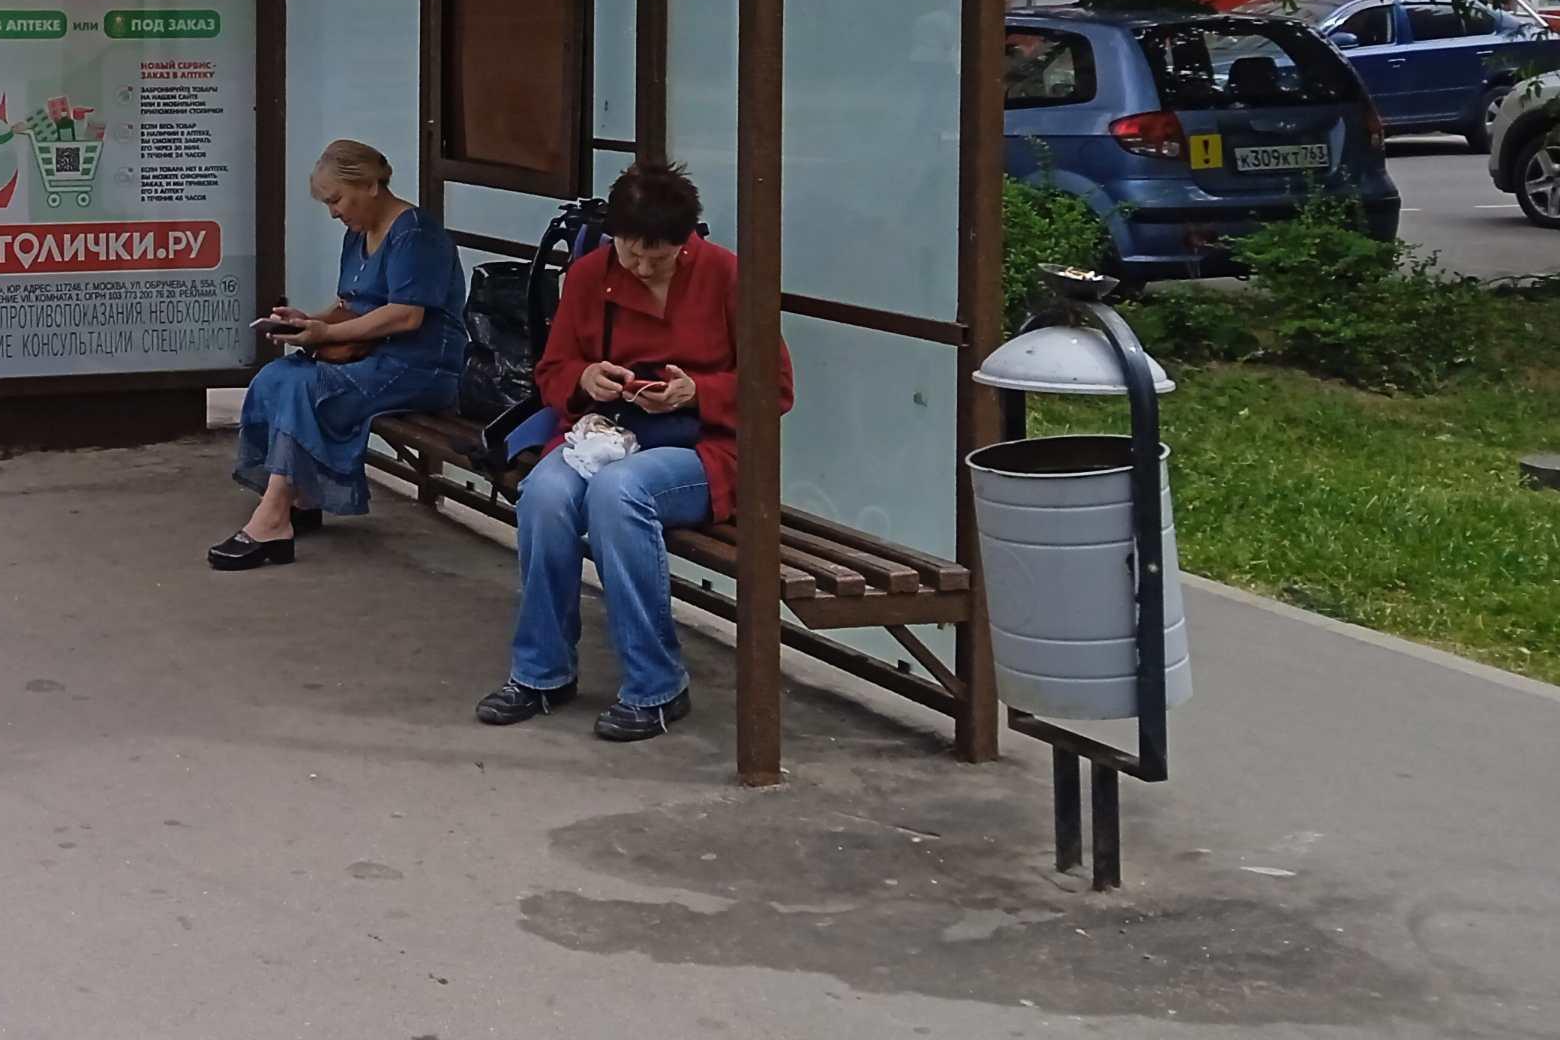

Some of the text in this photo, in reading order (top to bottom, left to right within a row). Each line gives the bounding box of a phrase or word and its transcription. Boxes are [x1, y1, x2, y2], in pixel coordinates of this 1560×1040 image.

[5, 20, 62, 31] АПТЕКЕ
[131, 19, 216, 32] ПОД ЗАКАЗ
[149, 298, 241, 326] НЕОБХОДИМО
[22, 330, 133, 358] КОНСУЛЬТАЦИИ
[142, 327, 241, 355] СПЕЦИАЛИСТА
